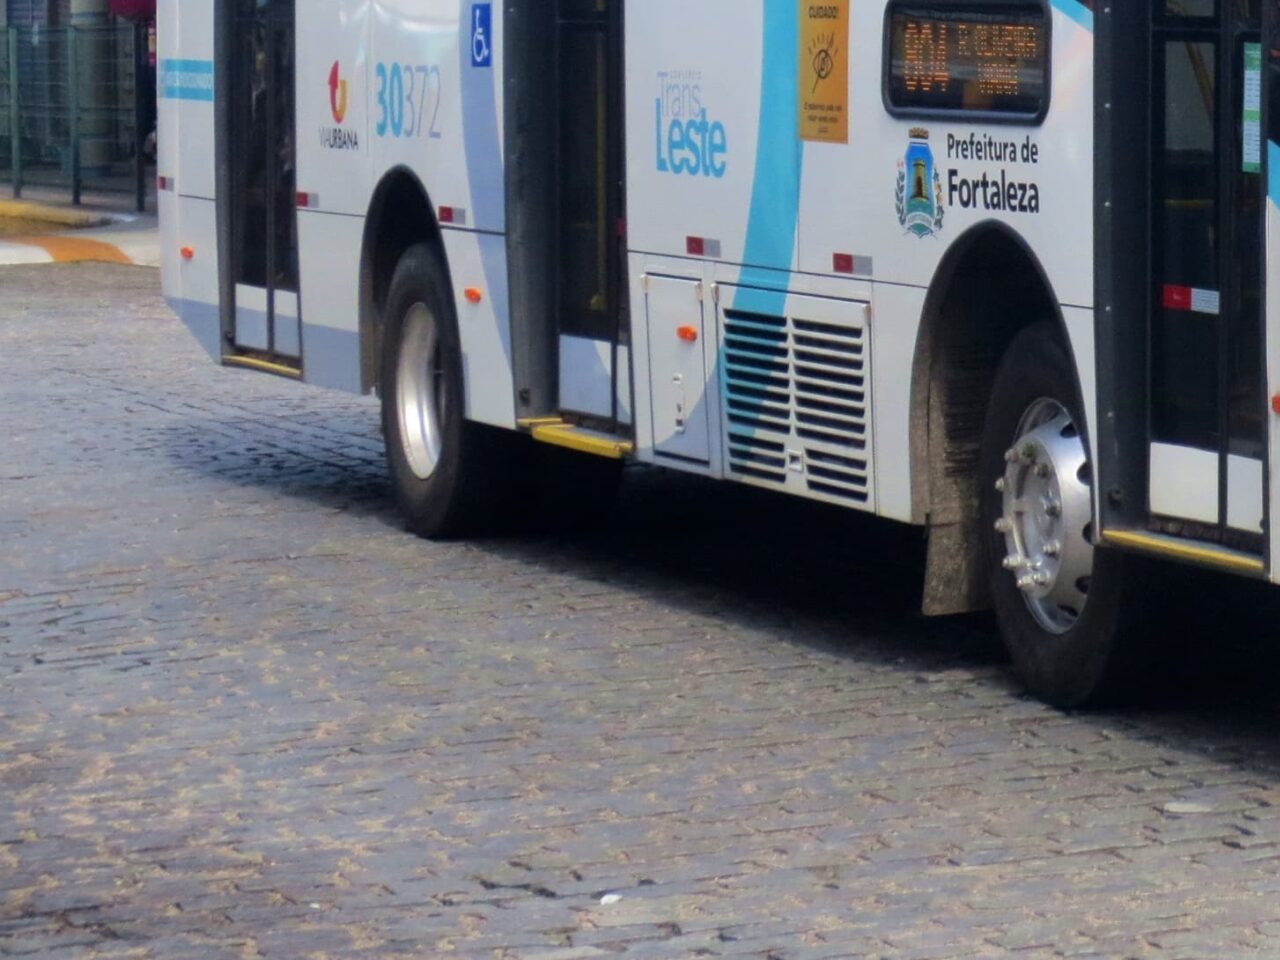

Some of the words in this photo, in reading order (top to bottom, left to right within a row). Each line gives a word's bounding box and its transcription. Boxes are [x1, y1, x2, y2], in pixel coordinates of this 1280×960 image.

[904, 23, 949, 92] 304
[375, 61, 442, 139] 30372
[657, 71, 702, 119] Trans
[656, 97, 727, 178] Leste
[947, 132, 1017, 162] Prefeitura
[1020, 135, 1039, 163] de
[947, 168, 1040, 214] Fortaleza
